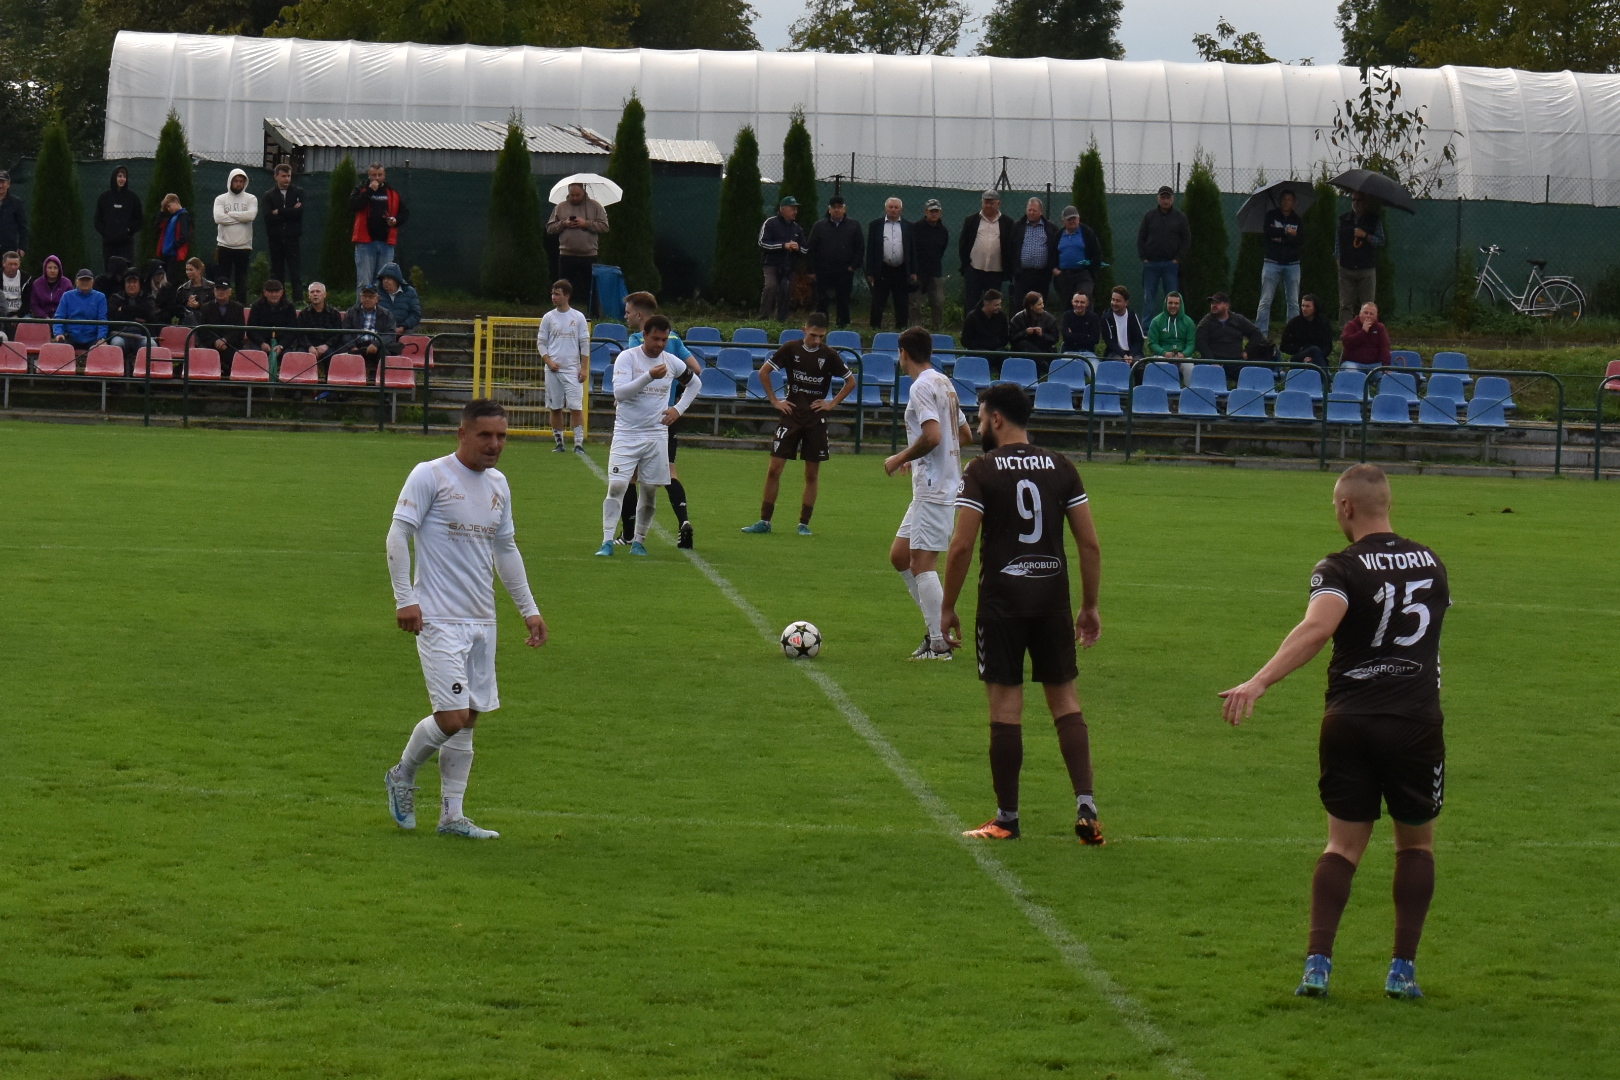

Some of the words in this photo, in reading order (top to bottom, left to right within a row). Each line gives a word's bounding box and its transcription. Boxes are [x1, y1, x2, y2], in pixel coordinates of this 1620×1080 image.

[793, 372, 824, 383] TOBACCO
[776, 426, 788, 439] 47
[995, 456, 1055, 470] VICTORIA
[1016, 478, 1043, 544] 9
[1018, 561, 1058, 569] AGROBUD
[1358, 550, 1437, 570] VICTORIA
[1370, 578, 1434, 648] 15
